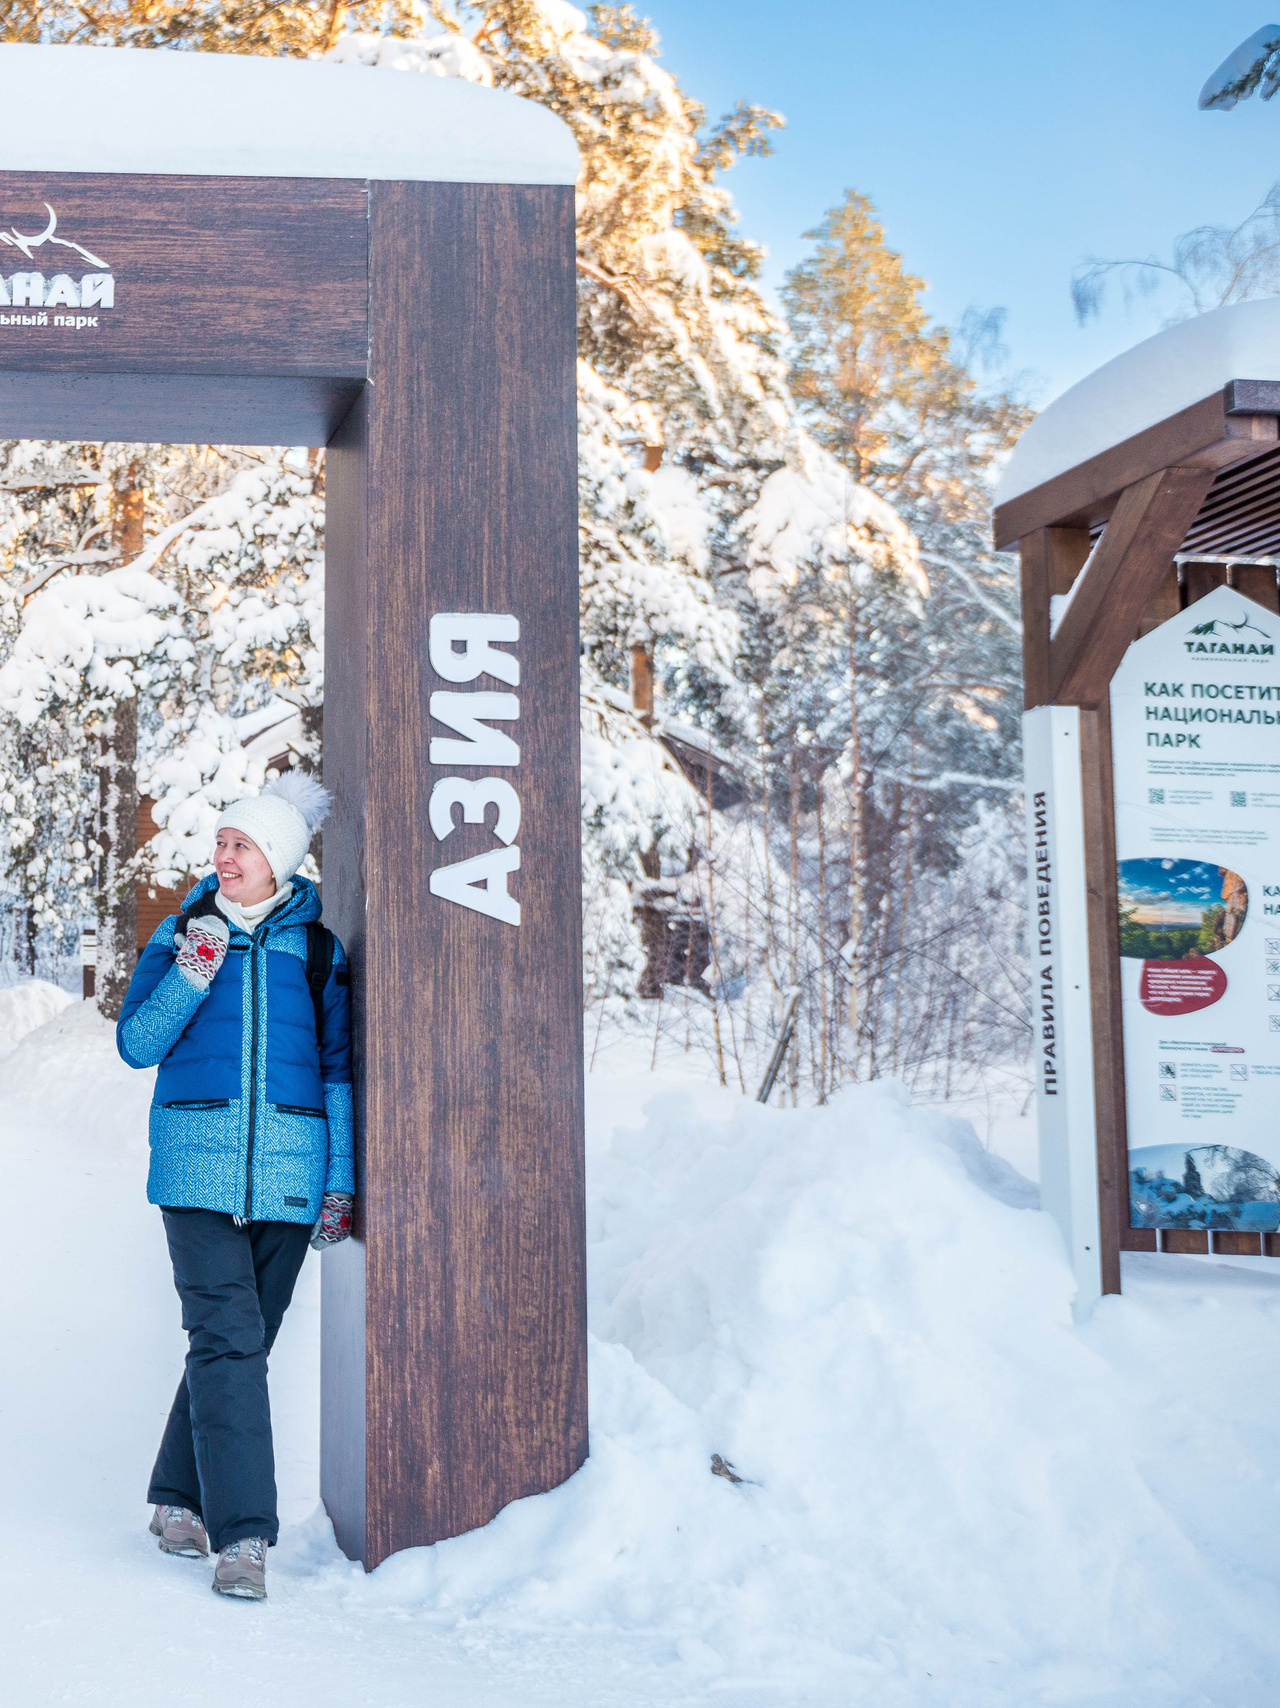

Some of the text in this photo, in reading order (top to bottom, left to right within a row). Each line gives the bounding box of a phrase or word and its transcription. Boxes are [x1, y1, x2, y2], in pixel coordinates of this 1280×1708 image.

[53, 315, 99, 330] парк
[1144, 682, 1183, 698] КАК
[1147, 732, 1201, 749] ПАРК
[428, 612, 522, 926] АЗИЯ
[1033, 791, 1058, 1096] ПРАВИЛА ПОВЕДЕНИЯ
